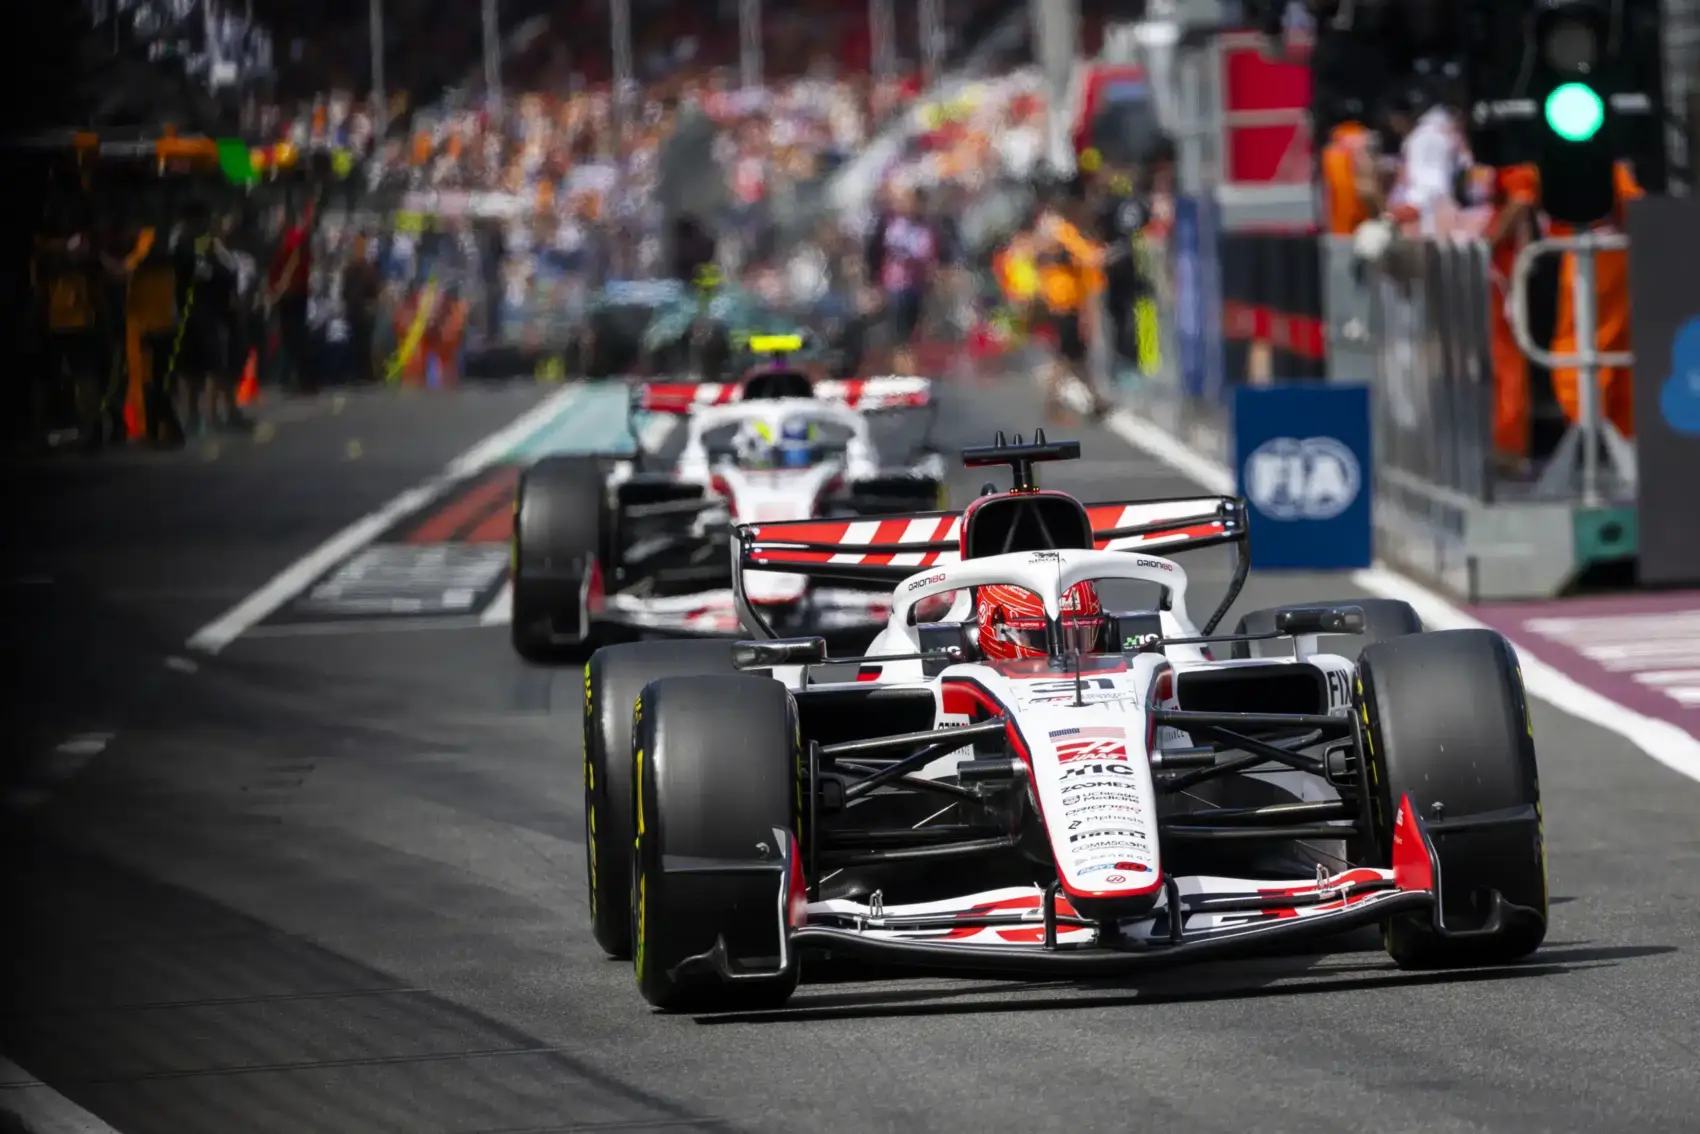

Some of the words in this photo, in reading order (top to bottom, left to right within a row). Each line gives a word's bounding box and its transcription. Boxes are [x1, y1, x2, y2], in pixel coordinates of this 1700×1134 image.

[908, 573, 946, 591] ORION180
[1061, 781, 1137, 794] ZOOMEX
[1083, 795, 1140, 804] Medicine
[1086, 814, 1144, 824] Mphasis
[1069, 828, 1146, 843] PIRELLI
[1071, 840, 1149, 853] COMMSCOPE
